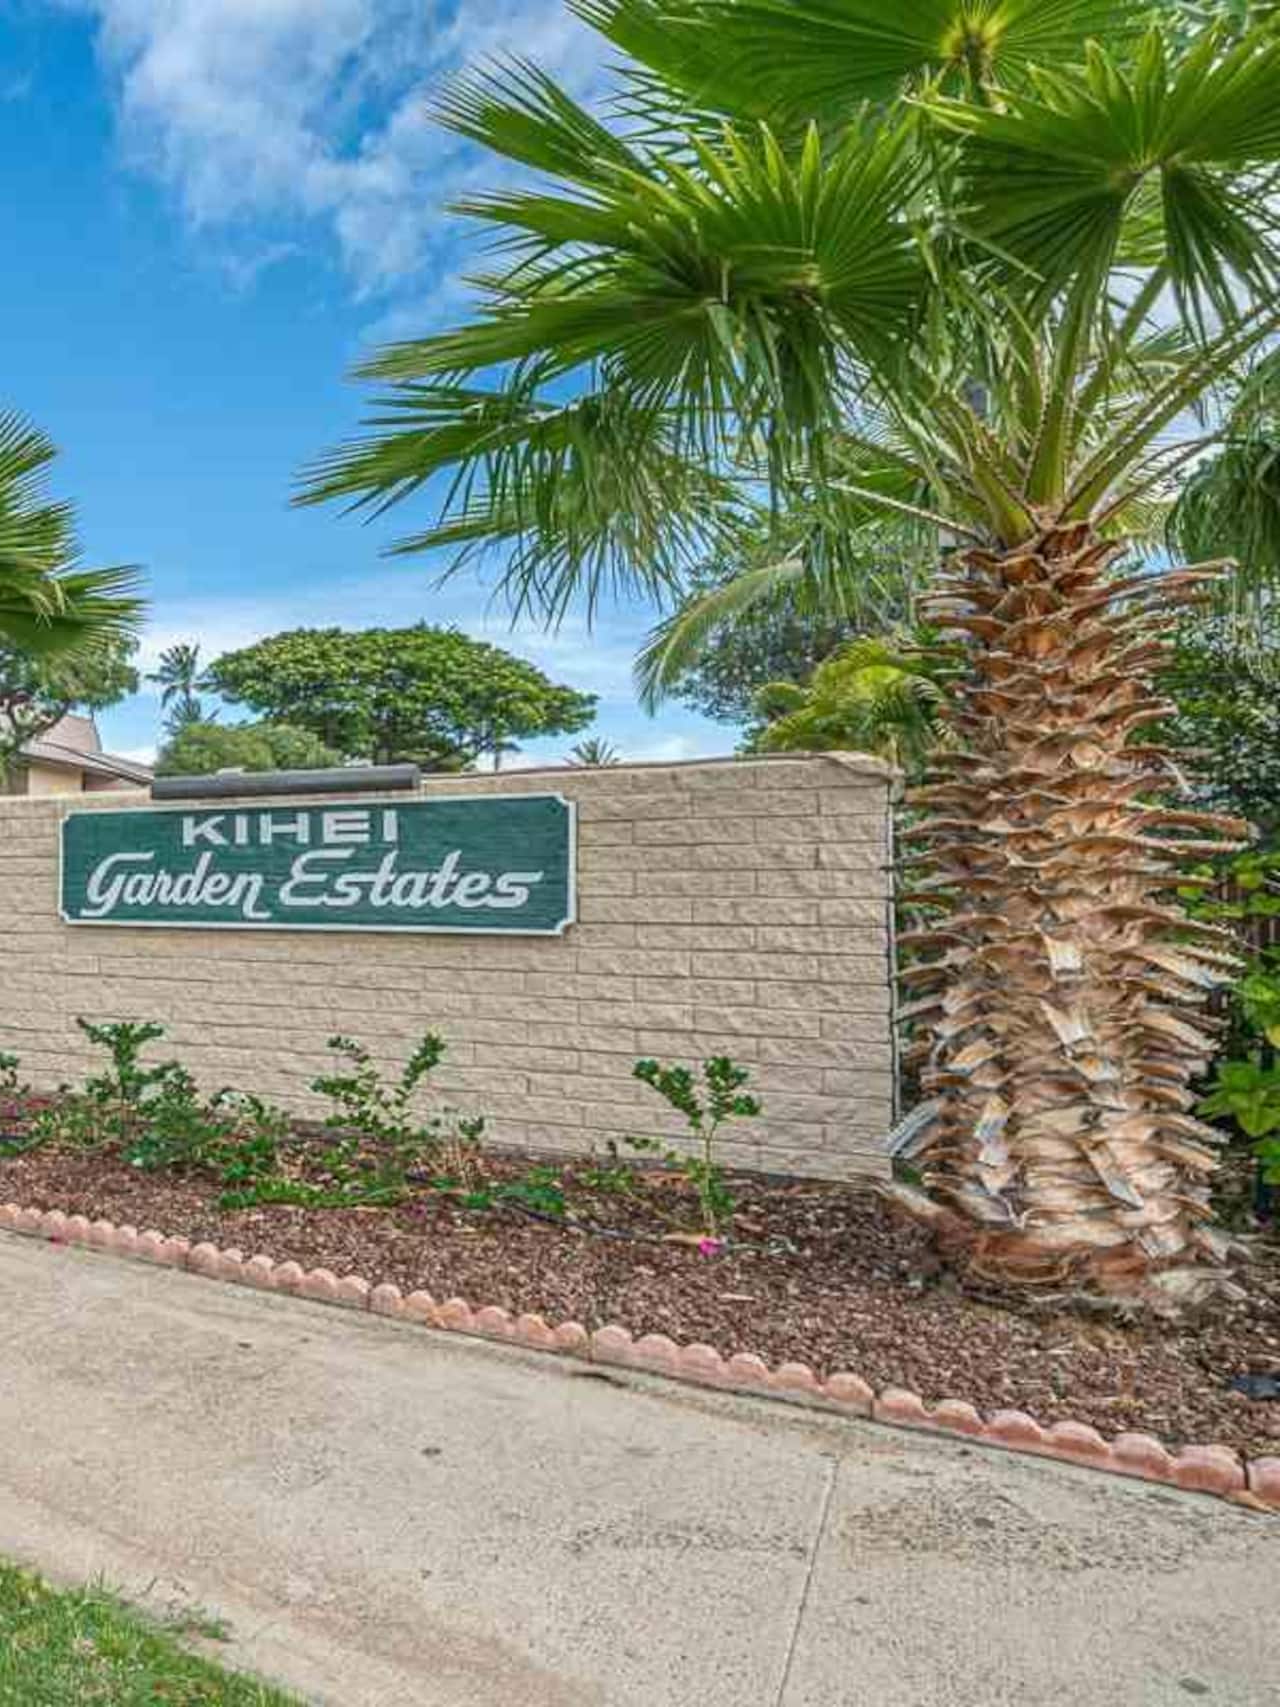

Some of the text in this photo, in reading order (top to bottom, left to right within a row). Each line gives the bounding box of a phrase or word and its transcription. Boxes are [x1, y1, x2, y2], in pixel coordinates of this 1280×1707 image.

[182, 809, 399, 846] KIHEI
[80, 848, 543, 919] Garden Estates
